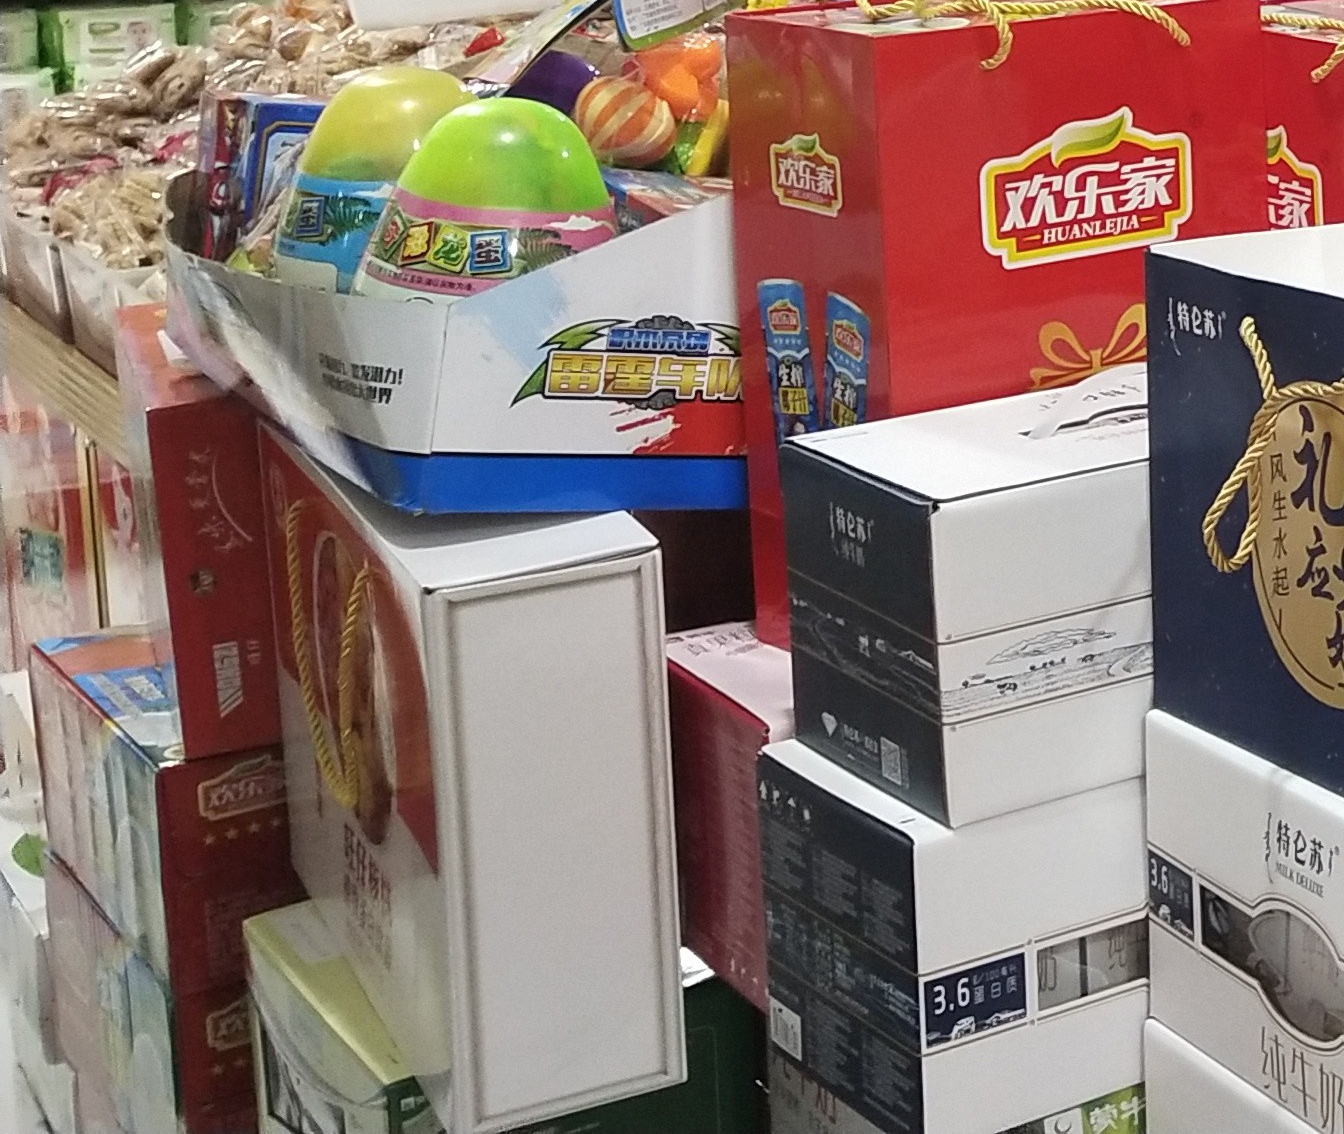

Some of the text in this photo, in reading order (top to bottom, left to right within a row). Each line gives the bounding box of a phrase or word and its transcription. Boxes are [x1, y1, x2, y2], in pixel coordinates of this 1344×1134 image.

[778, 156, 836, 197] 欢乐家
[1001, 155, 1176, 232] 欢乐家
[1042, 215, 1140, 245] HUANLEJIA
[1269, 451, 1290, 598] 风生水起
[1276, 821, 1326, 872] 特仑苏
[931, 976, 971, 1016] 3.6
